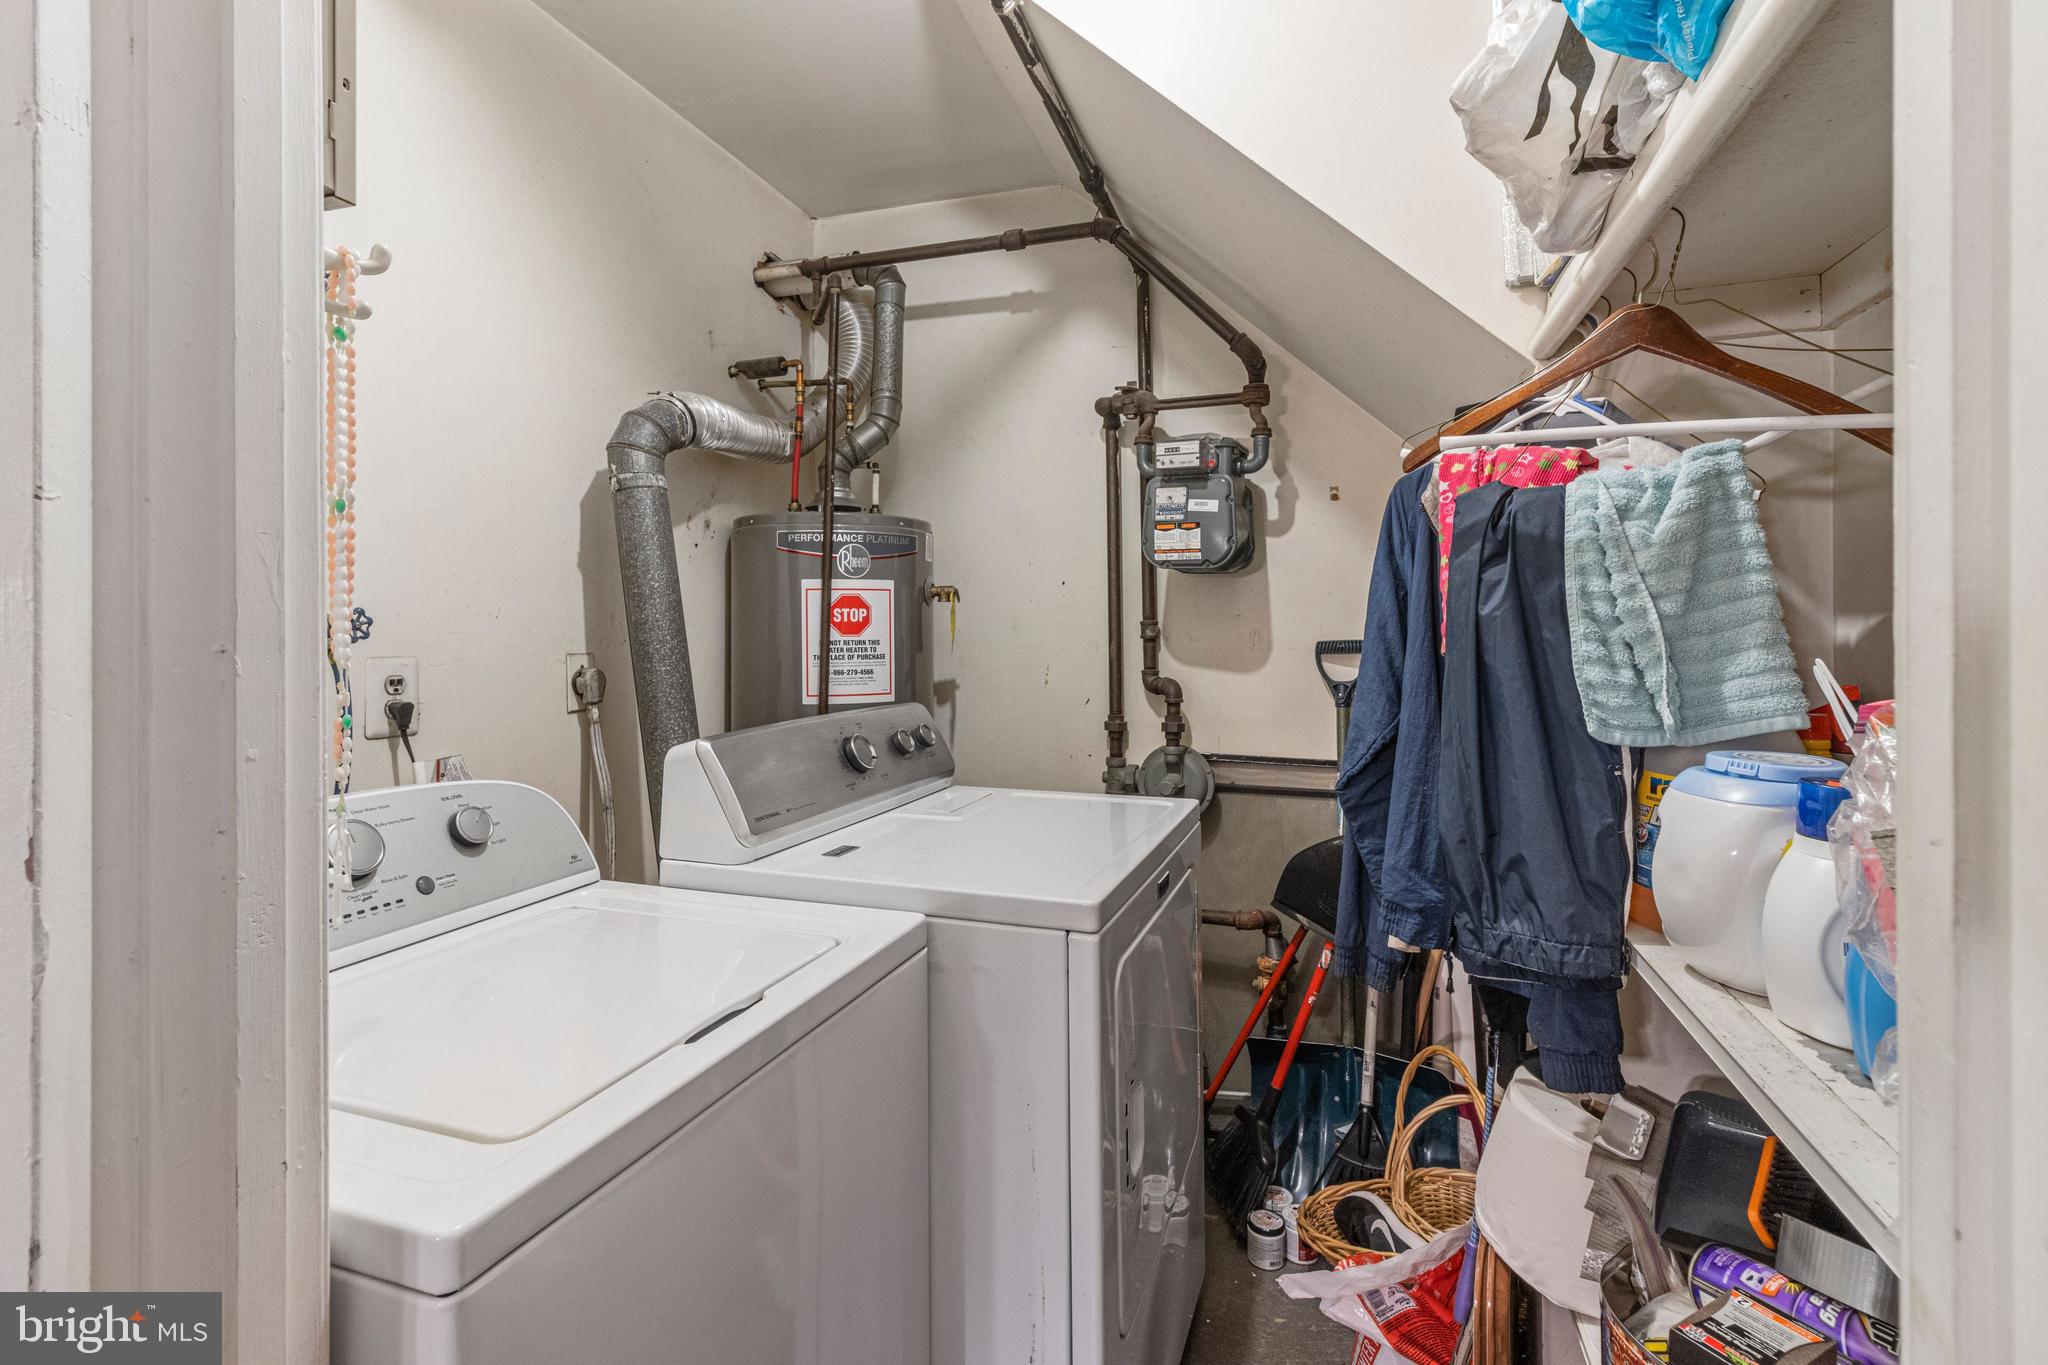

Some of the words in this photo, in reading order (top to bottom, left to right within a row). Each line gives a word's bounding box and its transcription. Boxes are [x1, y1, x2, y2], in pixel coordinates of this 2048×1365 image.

[788, 533, 863, 543] PERFOMANCE
[866, 534, 909, 544] PLATINUM
[841, 545, 868, 572] Rheem
[833, 607, 867, 622] STOP
